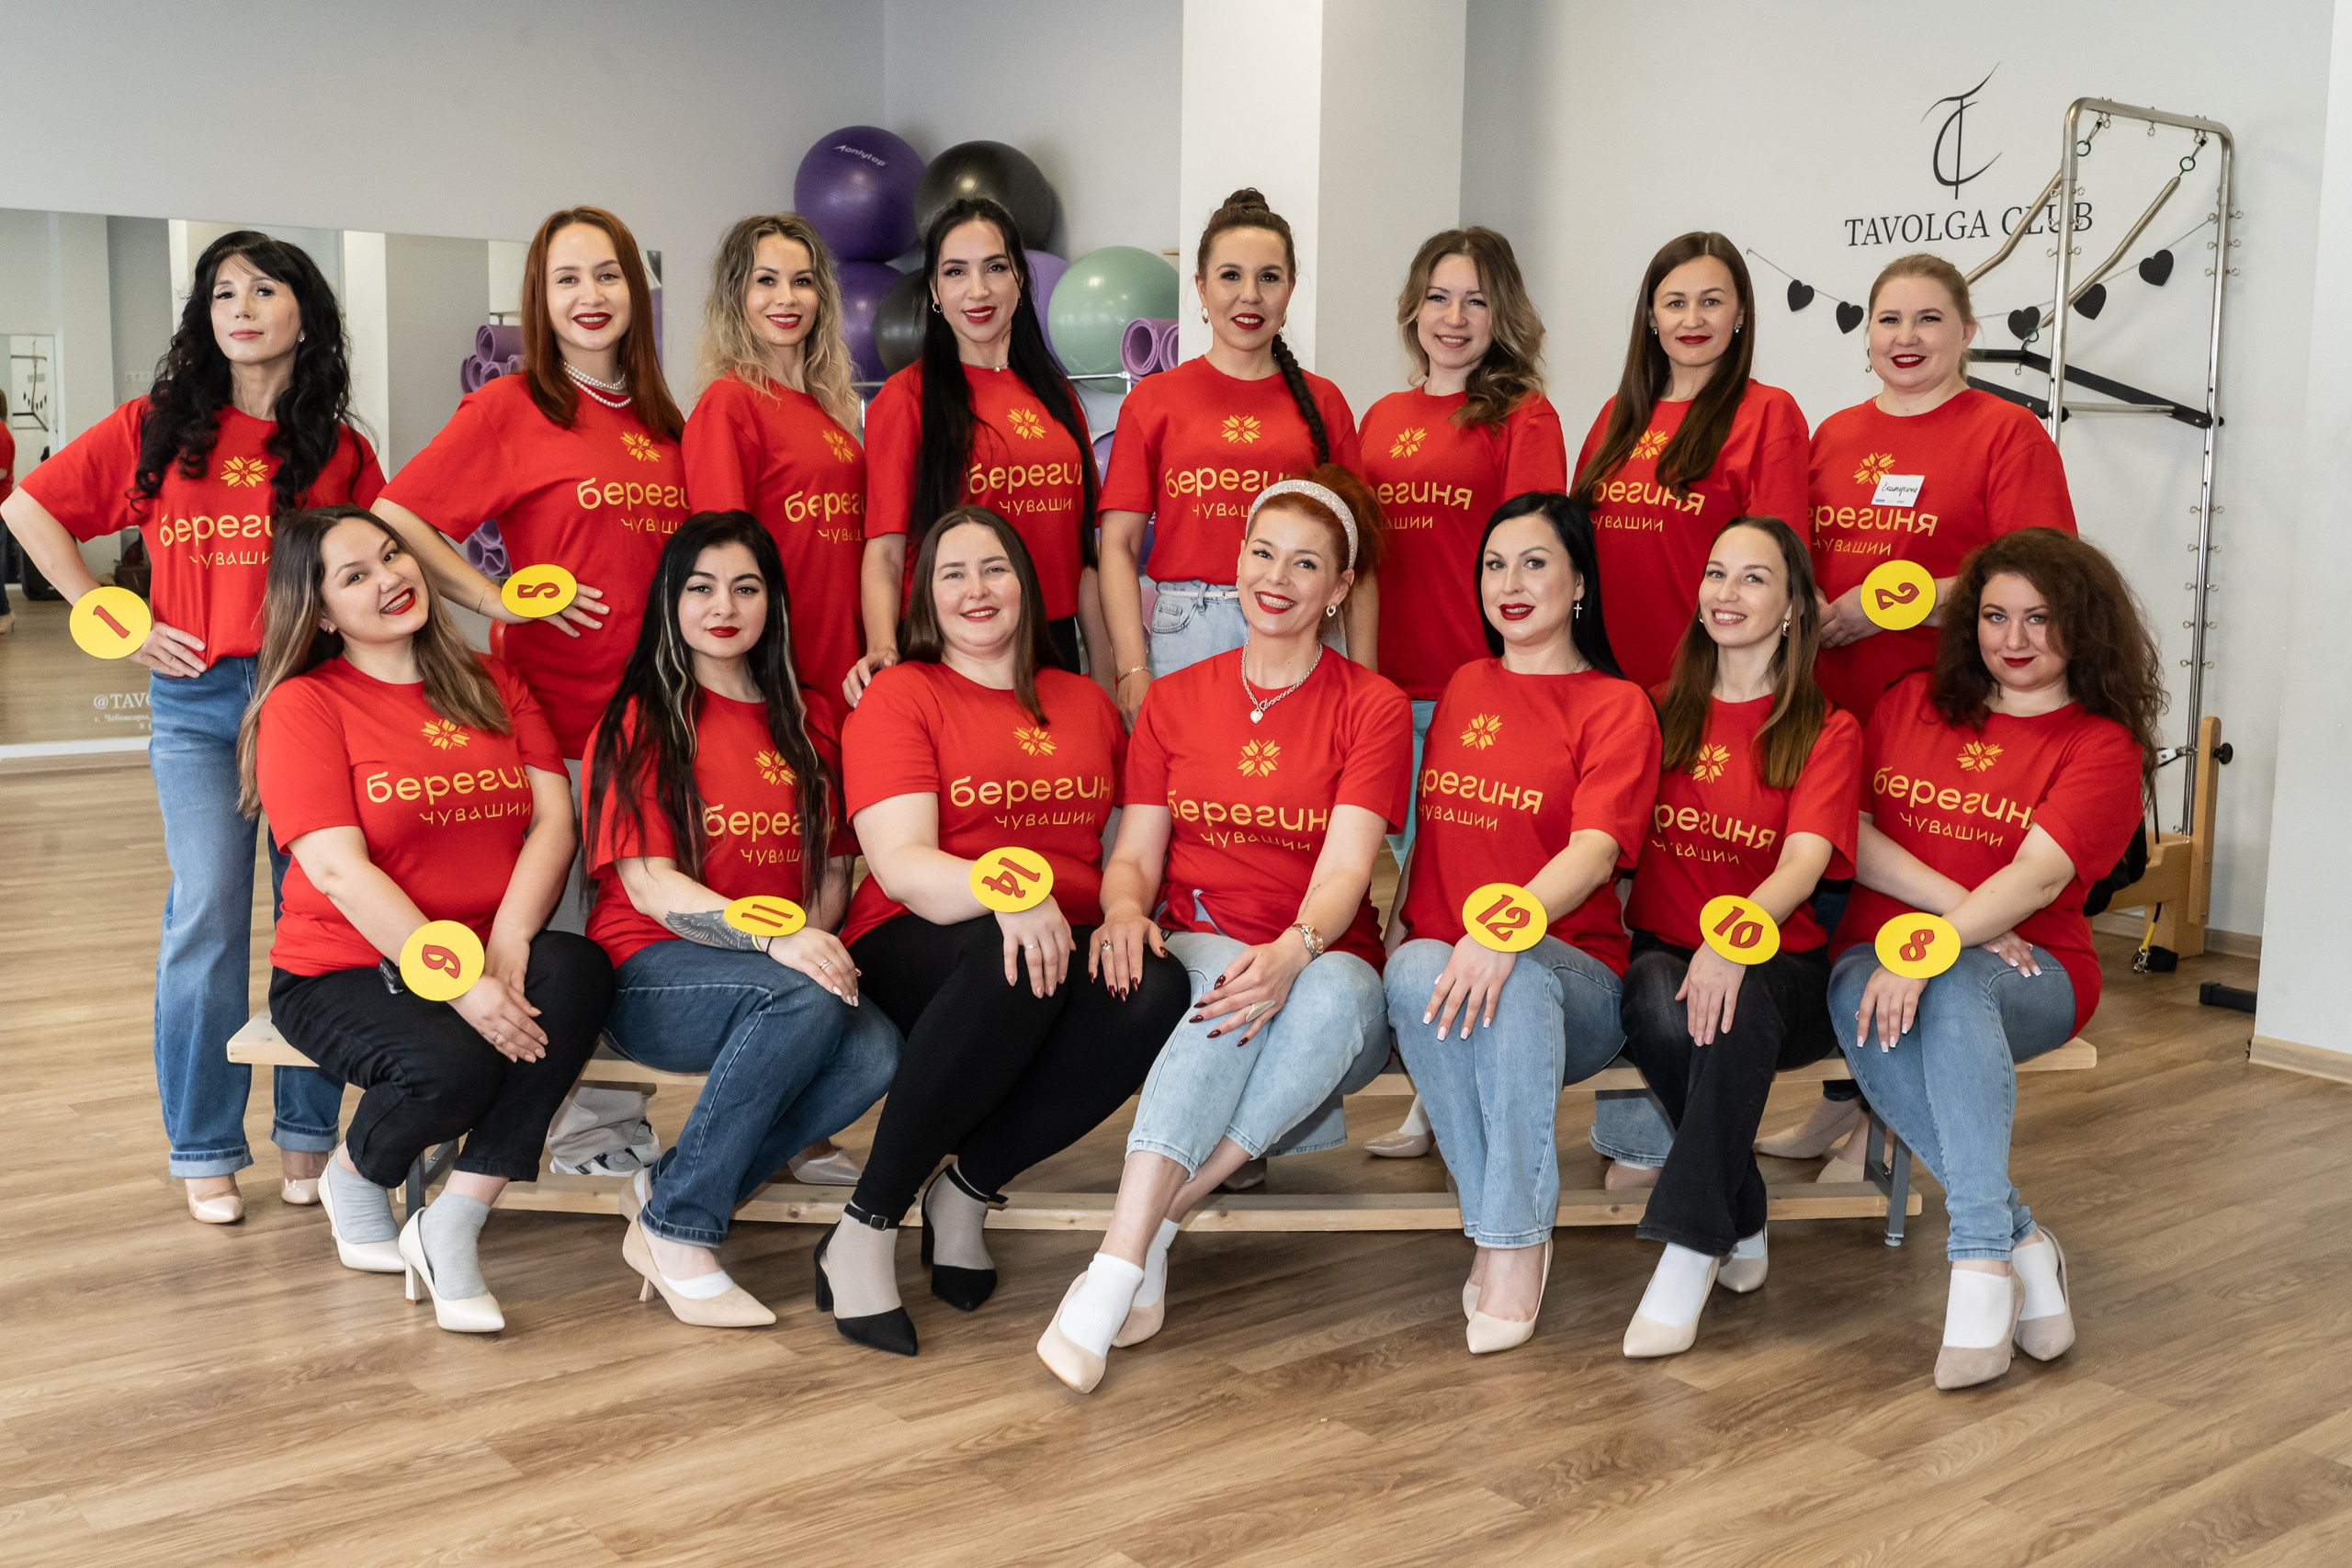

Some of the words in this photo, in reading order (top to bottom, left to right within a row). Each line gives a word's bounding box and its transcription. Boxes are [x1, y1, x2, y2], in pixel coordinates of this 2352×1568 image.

[1844, 209, 1991, 247] TAVOLGA
[967, 462, 1082, 494] береги
[1165, 467, 1291, 498] береги
[998, 497, 1073, 516] чуваши
[1376, 481, 1473, 511] егиня
[1808, 504, 1939, 537] региня
[1874, 581, 1920, 611] 2
[93, 604, 131, 639] 1
[93, 692, 152, 710] @TAV
[366, 766, 530, 806] берегин
[950, 775, 1112, 810] берегин
[1418, 768, 1544, 815] региня
[1872, 766, 2035, 830] берегин
[419, 802, 532, 827] чувашии
[994, 811, 1098, 831] чувашии
[1167, 789, 1329, 832] берегин
[1418, 804, 1499, 832] чувашии
[1200, 830, 1310, 852] чувашии
[1654, 804, 1777, 853] региня
[1899, 812, 2004, 848] чувашии
[740, 848, 802, 867] чуваш
[981, 857, 1041, 898] 14
[741, 904, 794, 928] 11
[1476, 894, 1532, 942] 12
[1713, 906, 1764, 949] 10
[1899, 929, 1935, 962] 8
